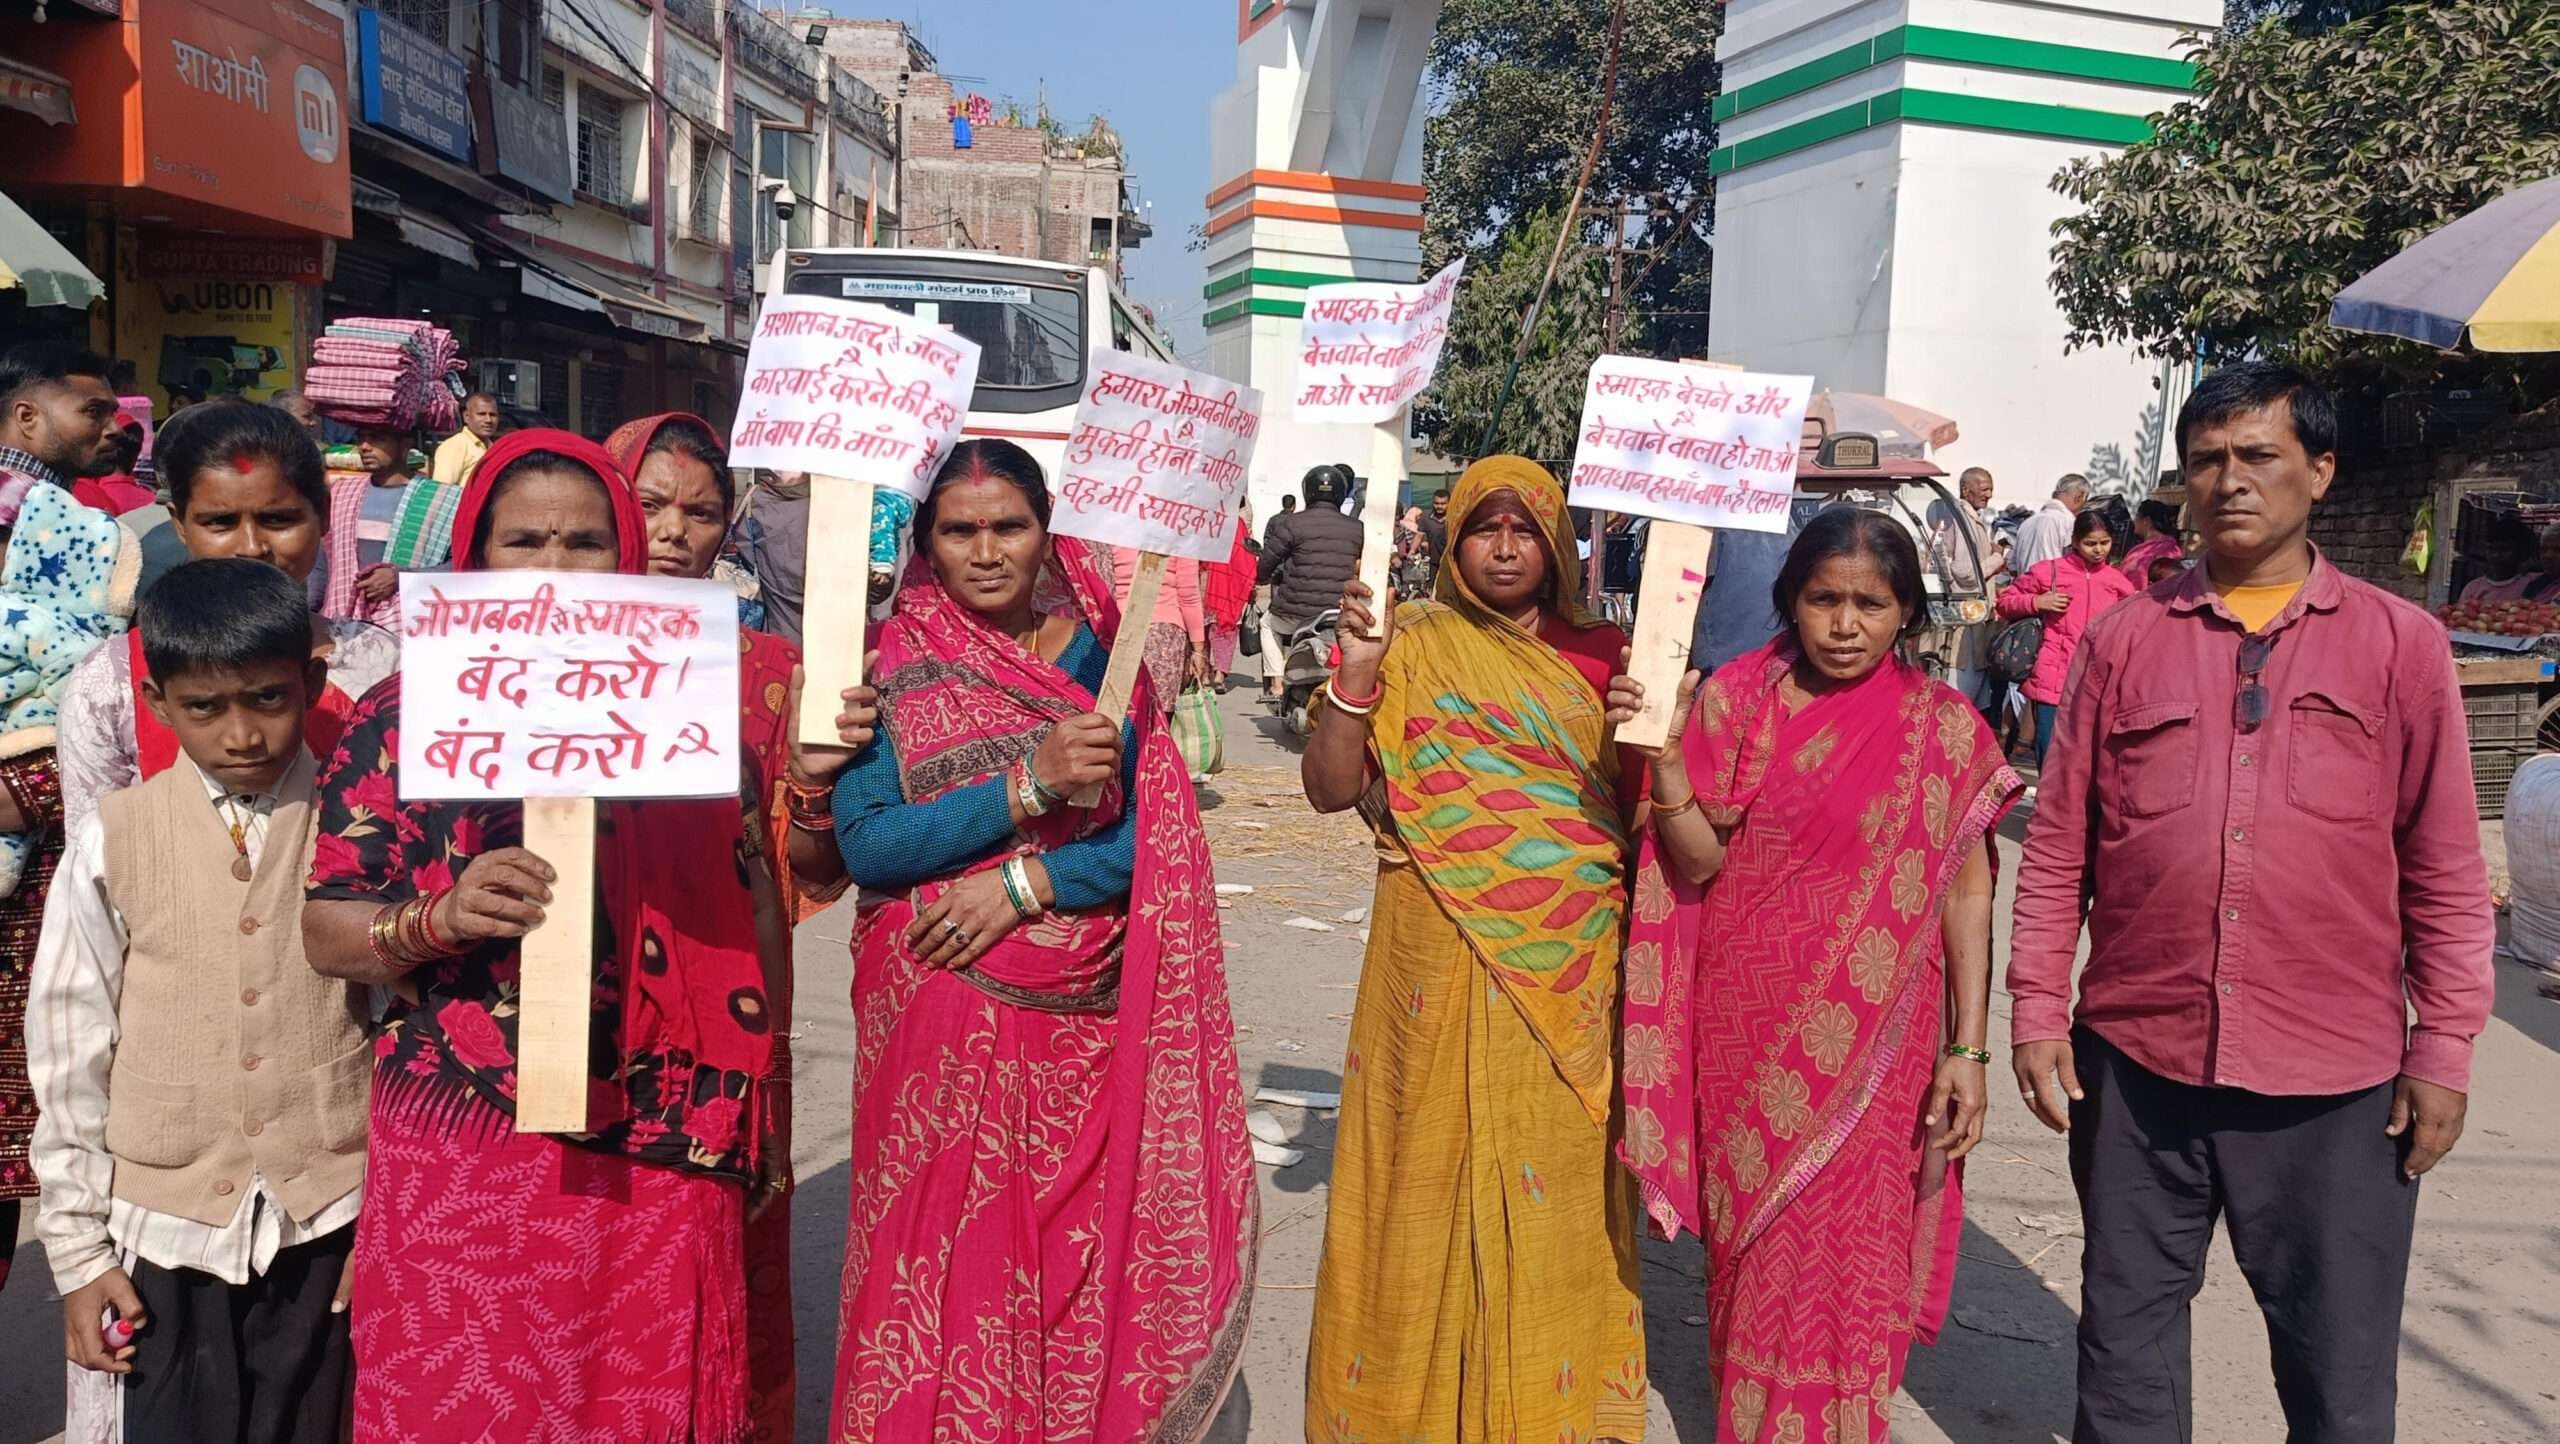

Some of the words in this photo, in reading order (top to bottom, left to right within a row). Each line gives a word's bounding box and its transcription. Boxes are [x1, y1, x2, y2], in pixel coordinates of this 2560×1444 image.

[171, 38, 269, 113] शाओमी
[380, 29, 404, 64] SAHU
[406, 43, 442, 84] MEDICAL
[443, 63, 465, 96] HALL
[380, 64, 406, 105] साहू
[406, 72, 443, 116] मेडिकल
[149, 252, 218, 271] GUPTA
[227, 254, 317, 274] TRADING
[864, 281, 925, 292] महाकाली
[1311, 299, 1381, 325] स्माइक
[759, 311, 840, 338] प्रशासन
[834, 317, 891, 356] जल्द
[905, 334, 966, 376] जल्द
[1304, 333, 1377, 368] बेचवाने
[751, 363, 833, 404] कारवाई
[829, 368, 895, 409] करने
[892, 379, 932, 417] की
[922, 399, 962, 432] हर
[1091, 370, 1170, 410] हमारा
[1162, 380, 1238, 429] जोगबनी
[1228, 407, 1258, 439] नशा
[1297, 373, 1356, 407] जाओ
[1595, 373, 1672, 403] स्माइक
[1676, 375, 1735, 414] बेचने
[1736, 386, 1792, 419] और
[735, 409, 767, 448] माँ
[764, 419, 805, 447] बाप
[805, 412, 842, 449] कि
[1070, 420, 1152, 464] मुक्ती
[1137, 429, 1198, 476] होना
[1201, 449, 1244, 494] चाहिए
[1585, 416, 1671, 455] बेचवाने
[1668, 434, 1728, 466] वाला
[1719, 434, 1747, 471] हो
[1743, 441, 1797, 474] जाओ
[1063, 474, 1104, 514] वह
[1100, 476, 1143, 514] भी
[1138, 493, 1209, 537] स्माइक
[1208, 500, 1228, 539] से
[1747, 489, 1792, 515] एलान
[406, 583, 558, 637] जोगबनी
[551, 606, 569, 635] से
[571, 598, 702, 647] स्माइक
[457, 644, 537, 709] बंद
[424, 718, 506, 790] बंद
[527, 711, 648, 778] करो
